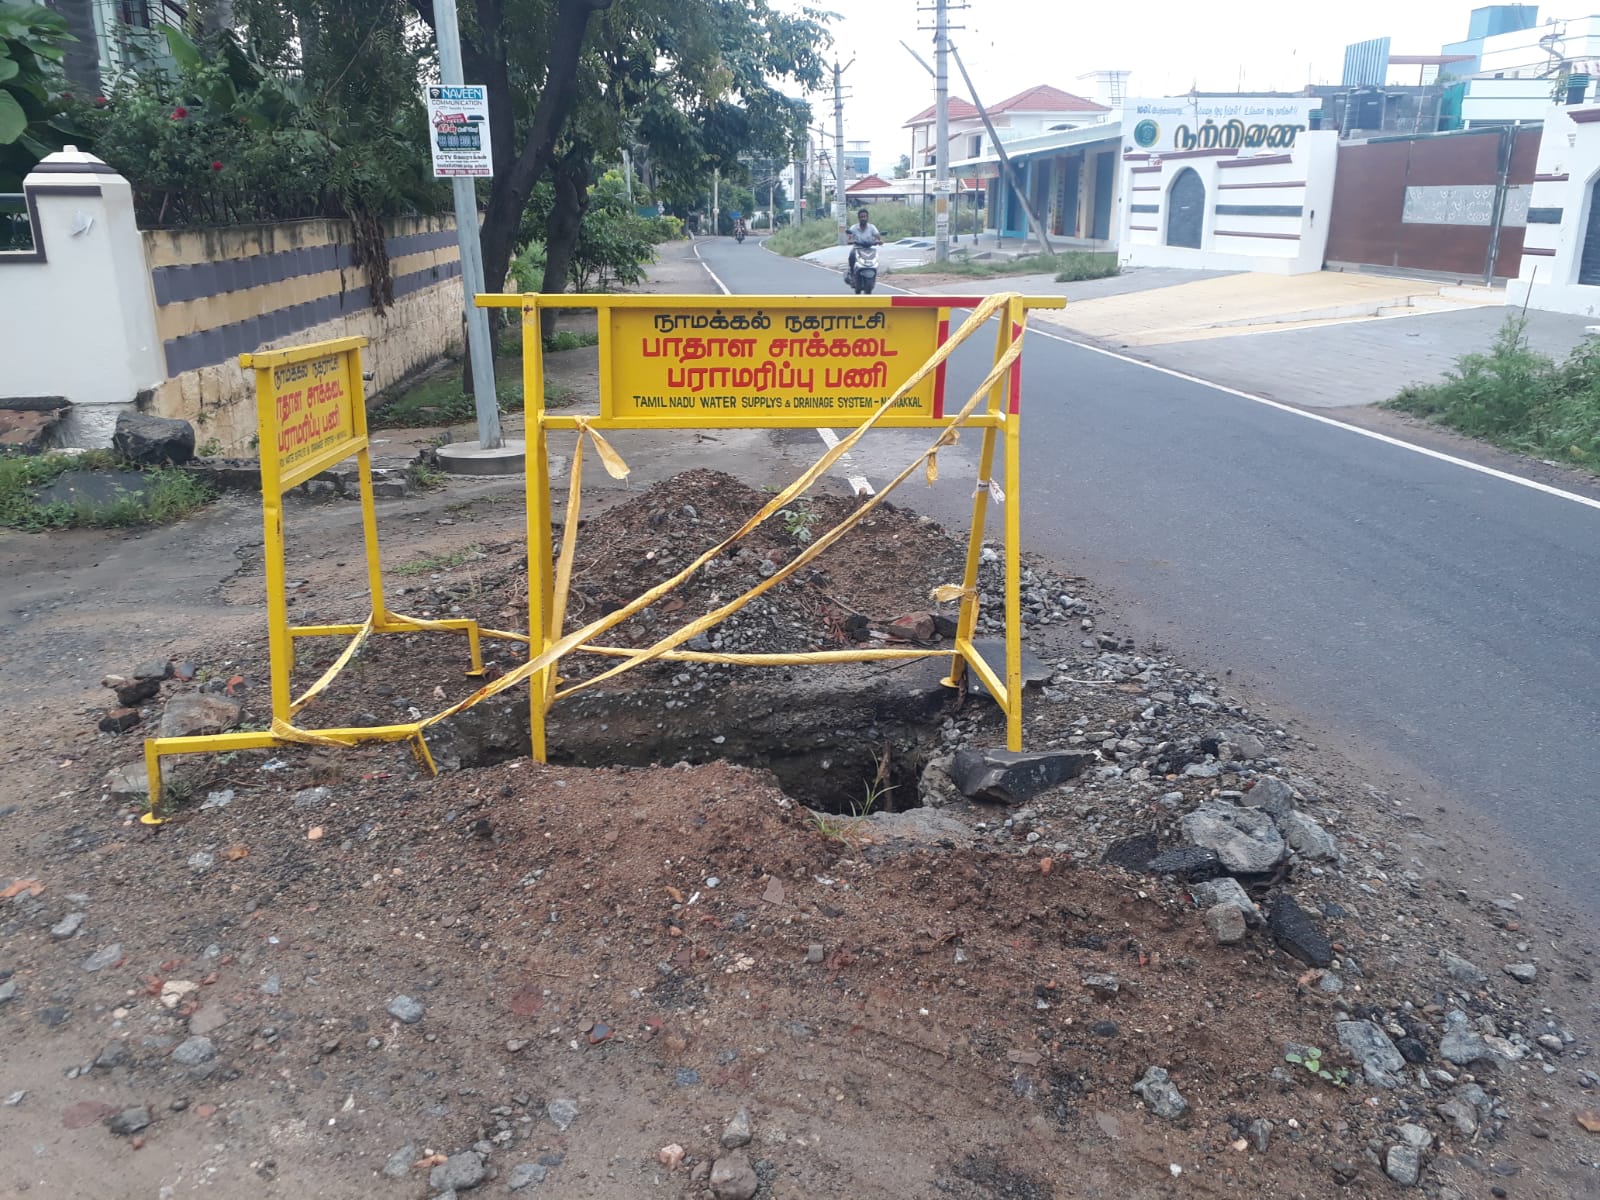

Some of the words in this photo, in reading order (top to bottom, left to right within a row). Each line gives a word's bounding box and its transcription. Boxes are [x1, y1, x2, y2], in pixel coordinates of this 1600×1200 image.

[442, 88, 481, 98] NAVEEN
[654, 309, 771, 333] நாமக்கல்
[785, 311, 886, 333] நகராட்சி
[642, 337, 757, 363] பாதாள
[769, 331, 898, 357] சாக்கடை
[668, 360, 814, 393] பராமரிப்பு
[825, 361, 887, 388] பணி
[633, 396, 667, 408] TAMIL
[669, 397, 695, 408] NADU
[700, 397, 736, 408] WATER
[741, 397, 782, 408] SUPPLYS
[785, 400, 790, 408] &
[793, 397, 834, 408] DRAINAGE
